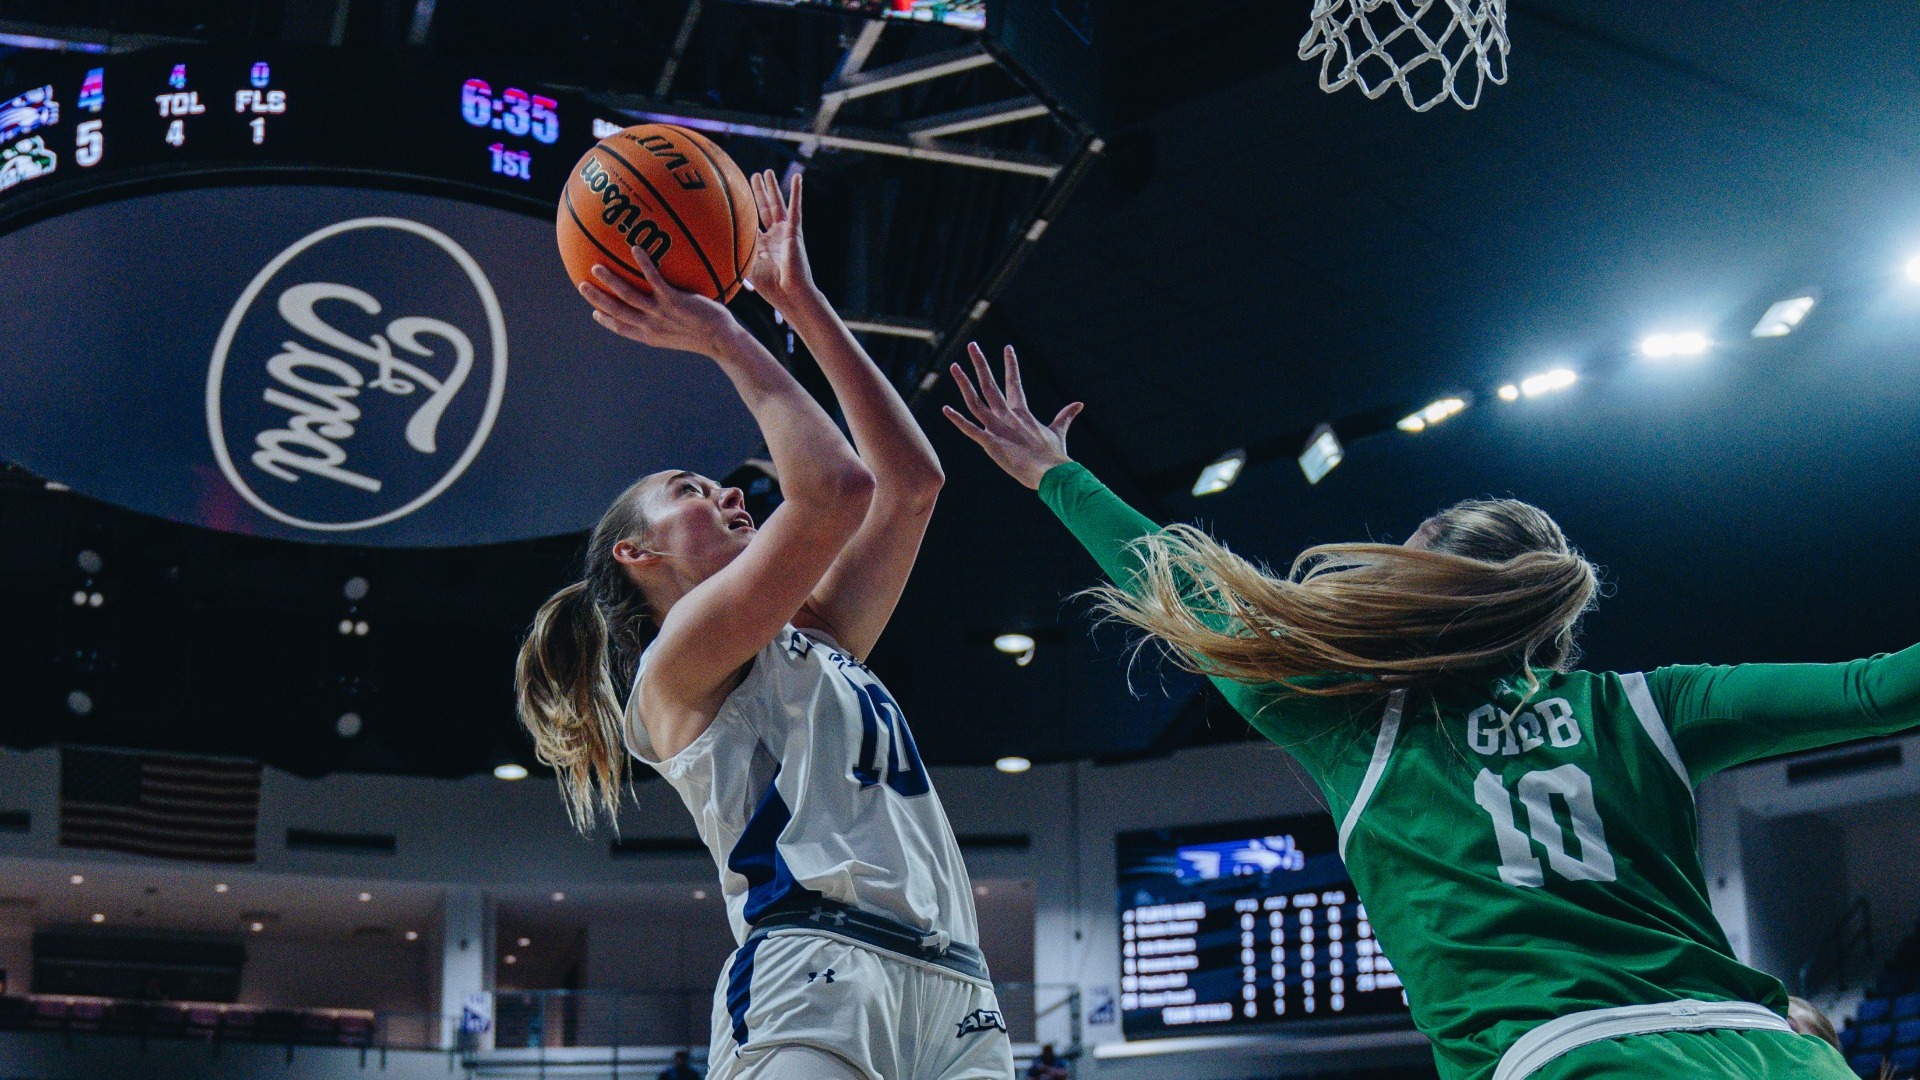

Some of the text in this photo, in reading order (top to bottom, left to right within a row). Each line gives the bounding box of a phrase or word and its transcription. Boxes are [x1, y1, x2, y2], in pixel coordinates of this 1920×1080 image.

[77, 66, 105, 113] 4
[168, 63, 187, 89] 4
[155, 91, 206, 117] TOL
[234, 90, 287, 113] FLS
[461, 78, 560, 145] 6:35
[75, 119, 104, 167] 5
[165, 119, 186, 147] 4
[249, 116, 266, 144] 1
[488, 143, 532, 181] 1st
[637, 135, 707, 190] EVO
[579, 155, 672, 269] Wilson
[251, 281, 475, 493] Ford
[843, 671, 931, 797] 10
[1473, 762, 1618, 888] 10
